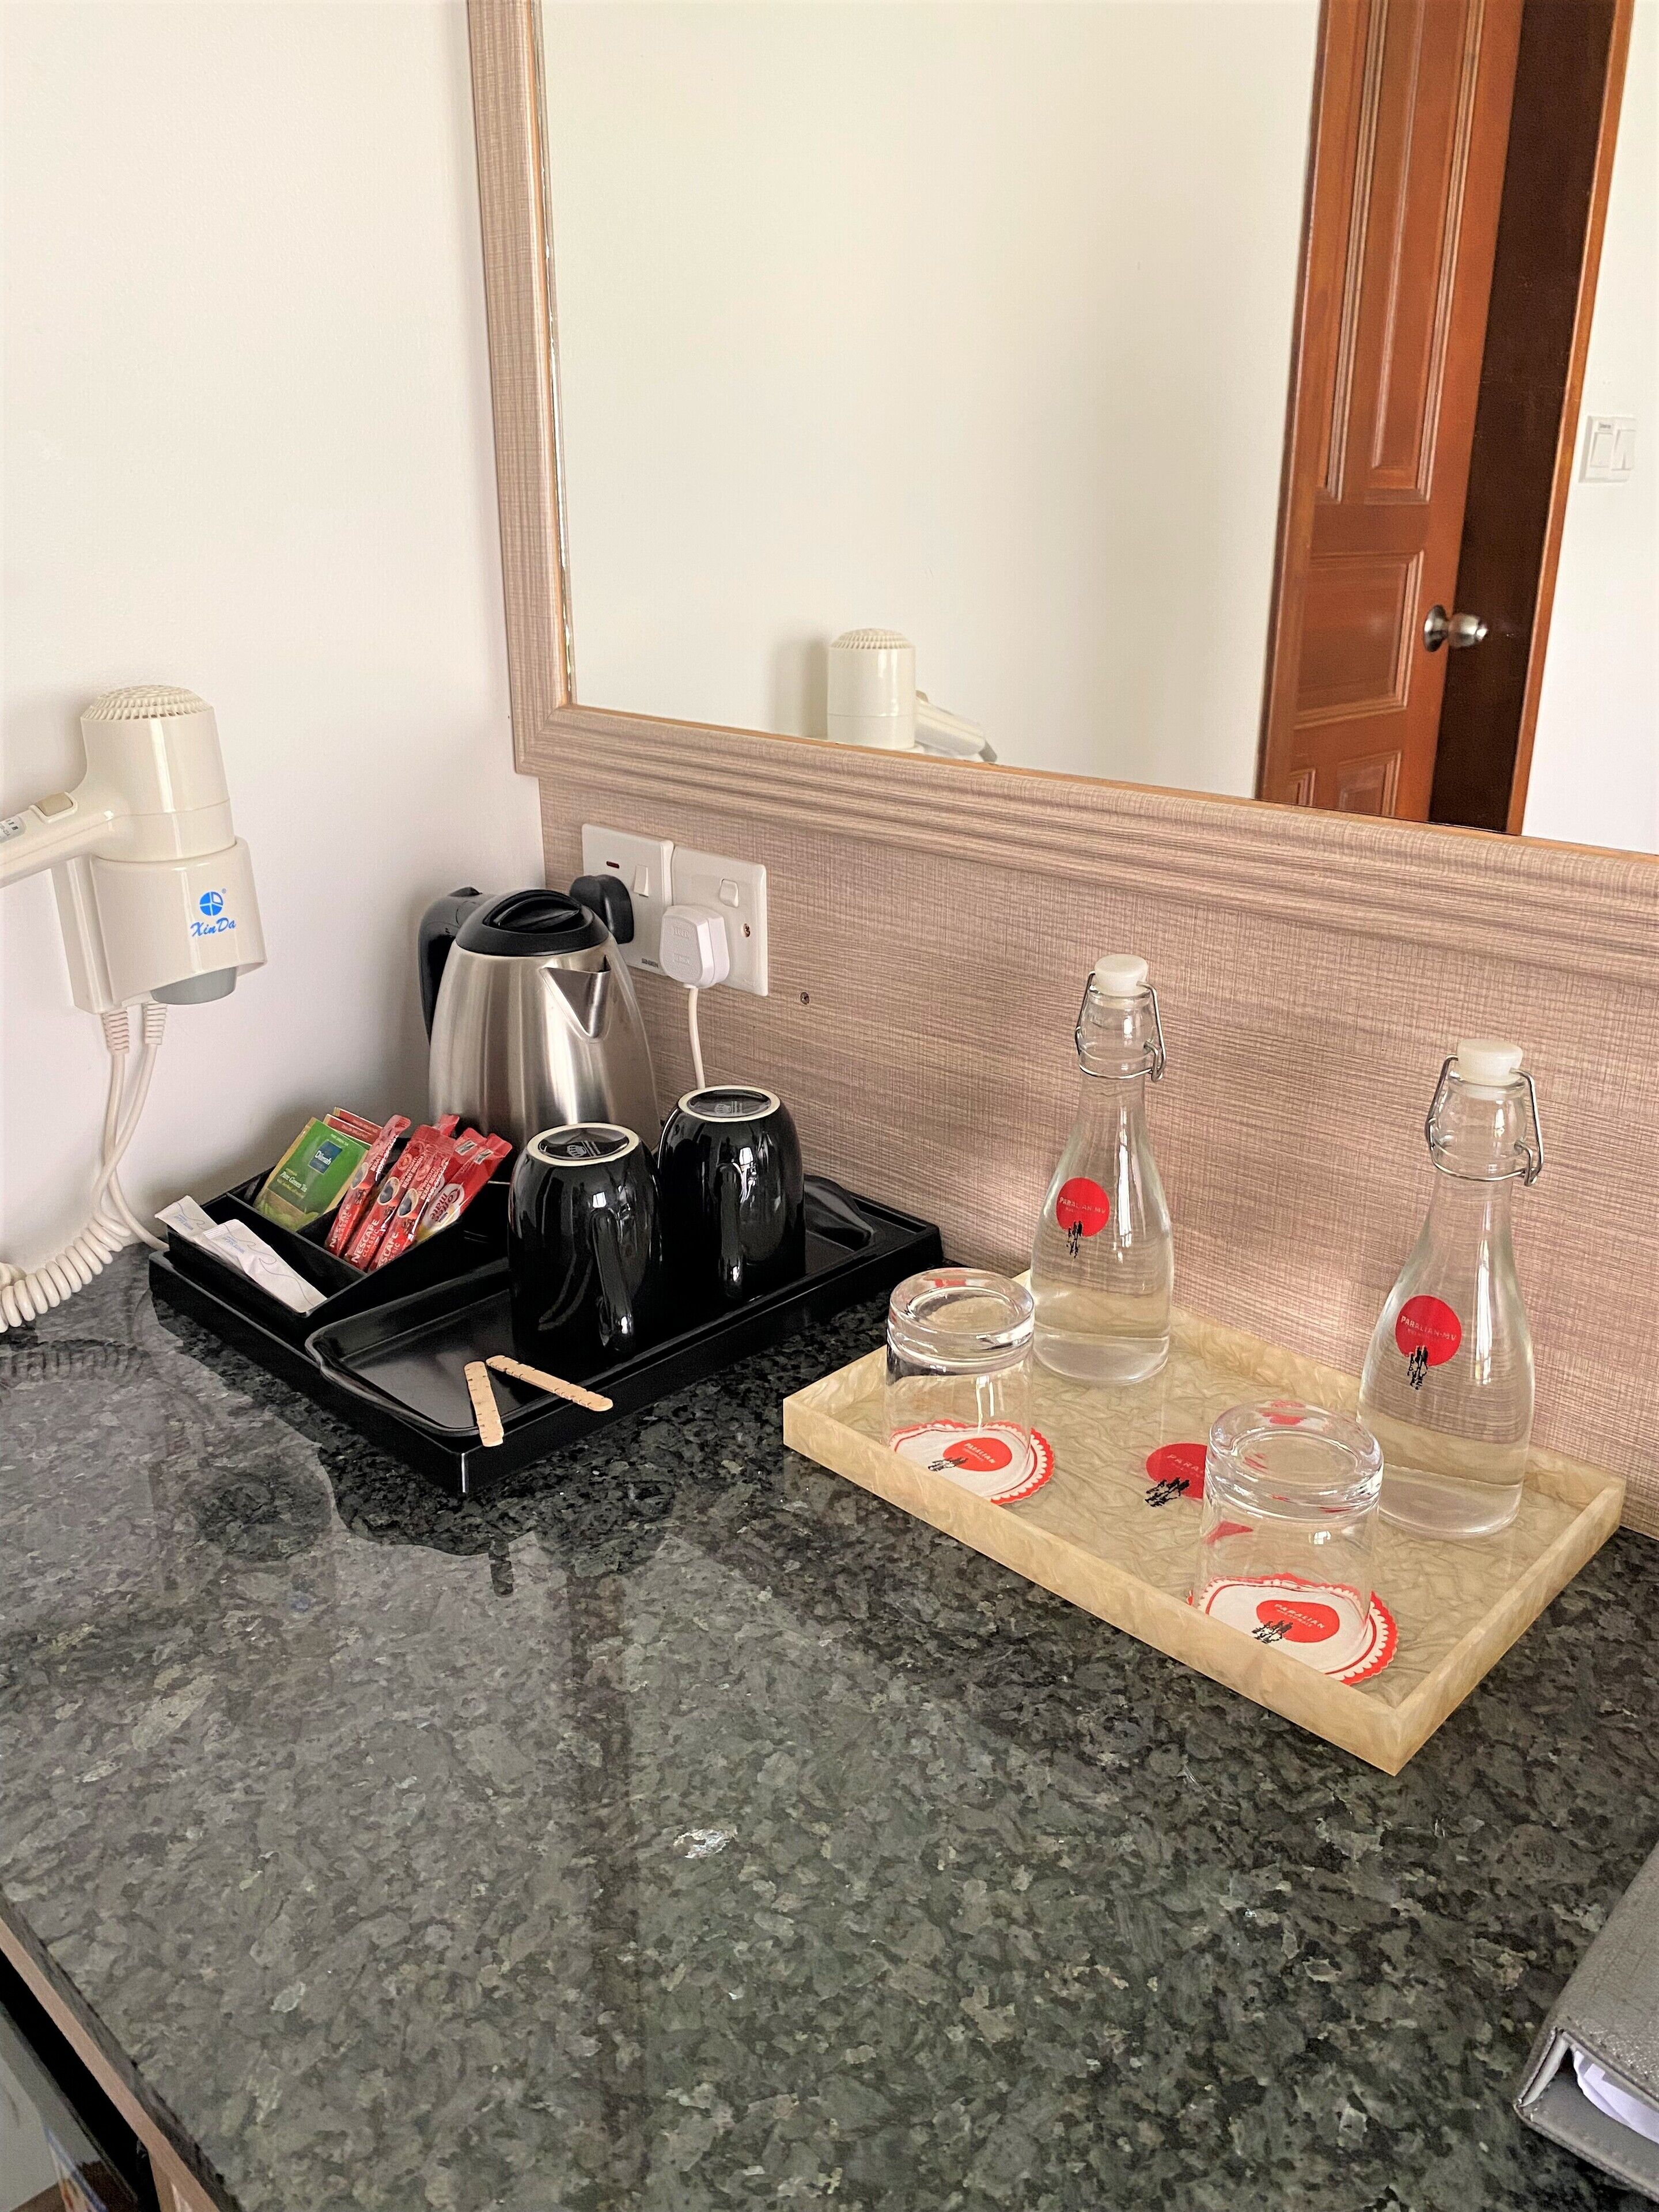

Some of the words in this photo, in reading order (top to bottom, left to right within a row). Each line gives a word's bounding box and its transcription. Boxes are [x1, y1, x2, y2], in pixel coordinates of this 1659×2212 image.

[190, 917, 236, 937] XinDa
[429, 1192, 448, 1219] mate
[361, 1228, 380, 1257] CLASSIC
[377, 1231, 400, 1267] ESCAFE
